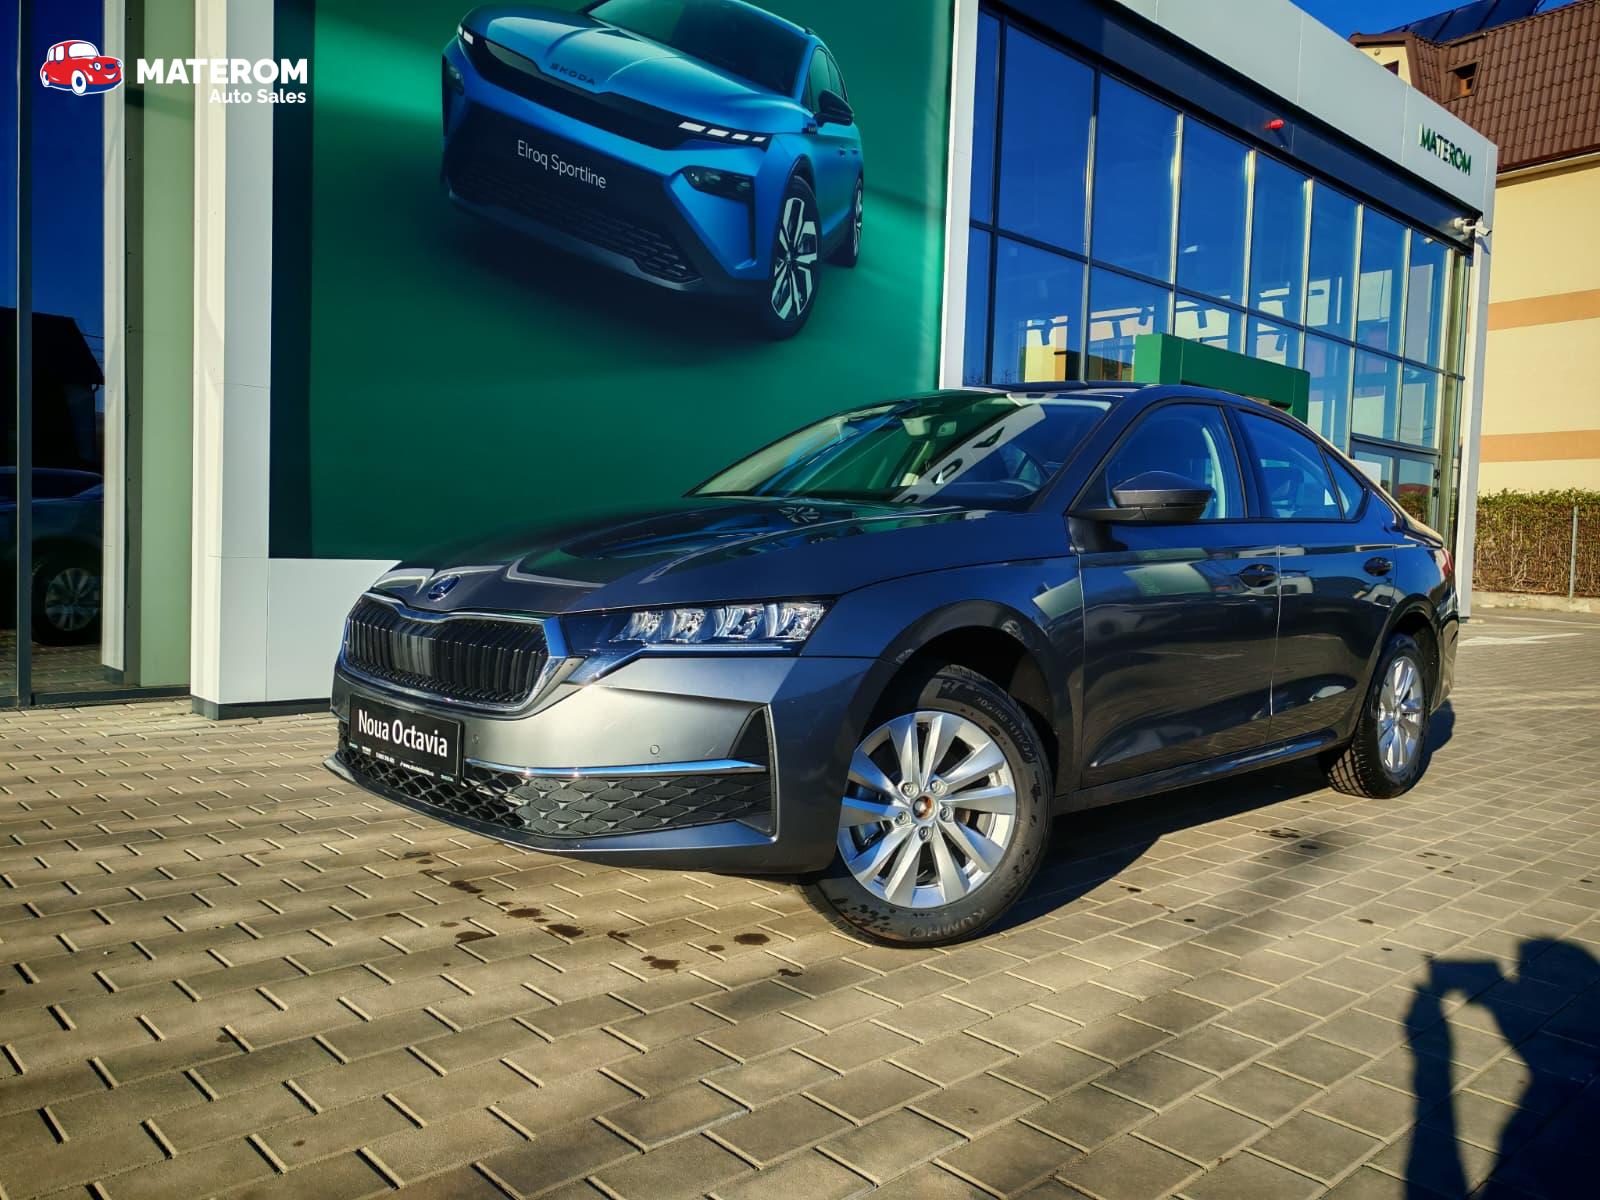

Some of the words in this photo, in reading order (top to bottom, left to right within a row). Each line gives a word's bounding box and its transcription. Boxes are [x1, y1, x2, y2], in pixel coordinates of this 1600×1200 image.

[517, 139, 548, 171] Elroq
[551, 153, 607, 189] Sportline
[1418, 122, 1472, 176] MATEROM
[358, 709, 389, 741] Noua
[392, 719, 448, 758] Octavia
